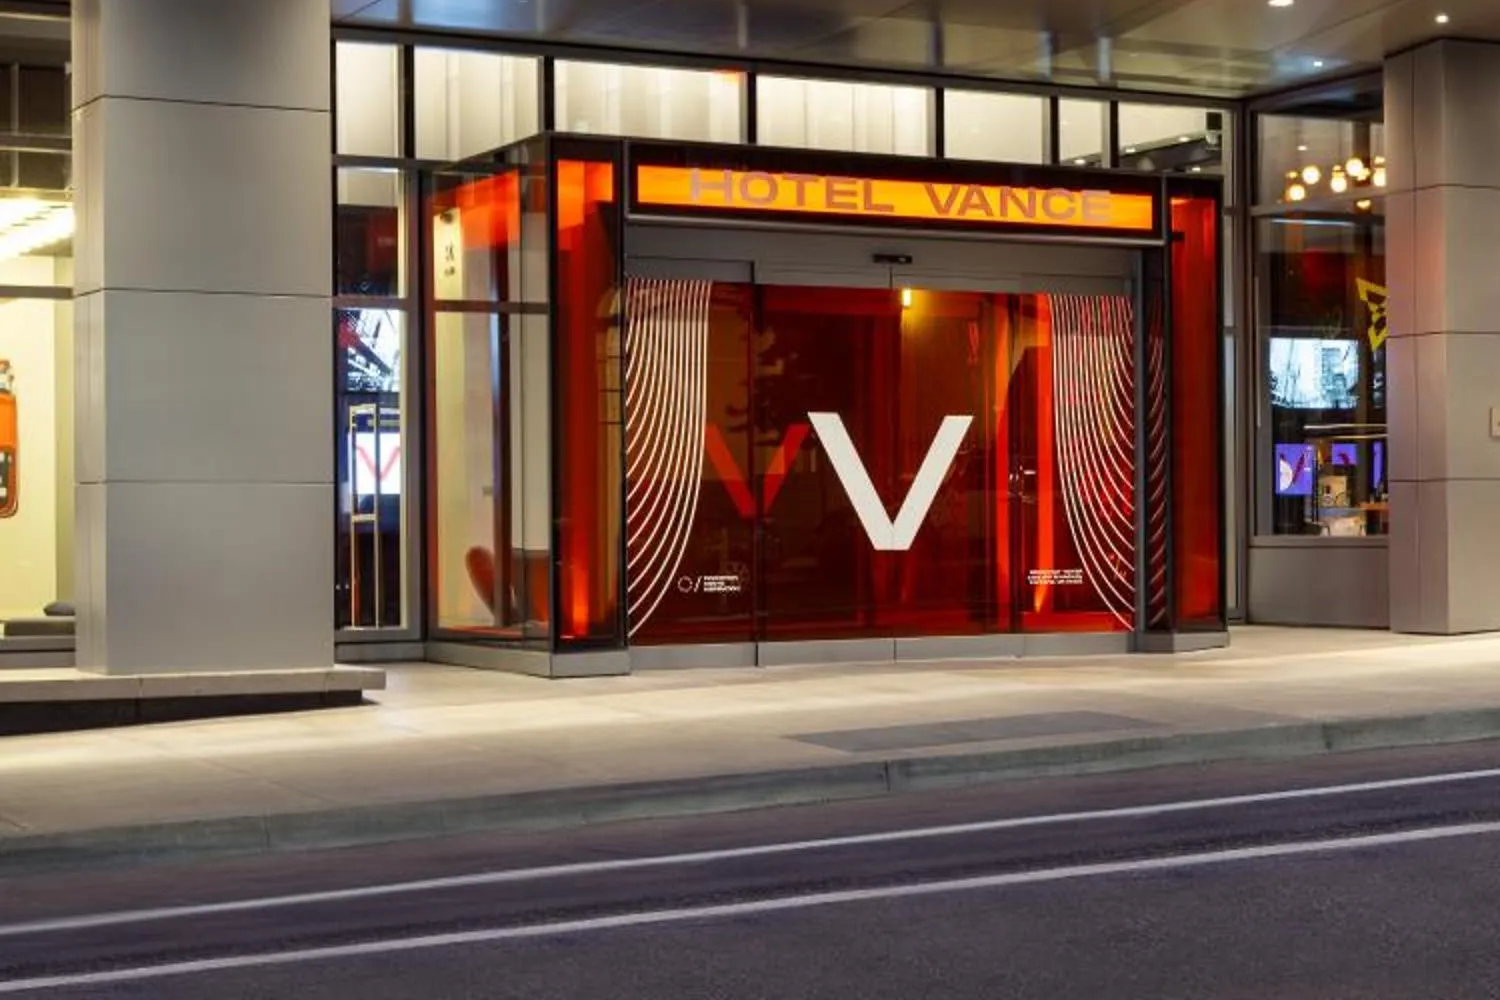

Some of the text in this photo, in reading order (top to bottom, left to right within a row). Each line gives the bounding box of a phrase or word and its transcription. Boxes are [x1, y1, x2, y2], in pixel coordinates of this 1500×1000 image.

[689, 167, 1114, 223] HOTEL VANCE
[807, 411, 974, 551] V
